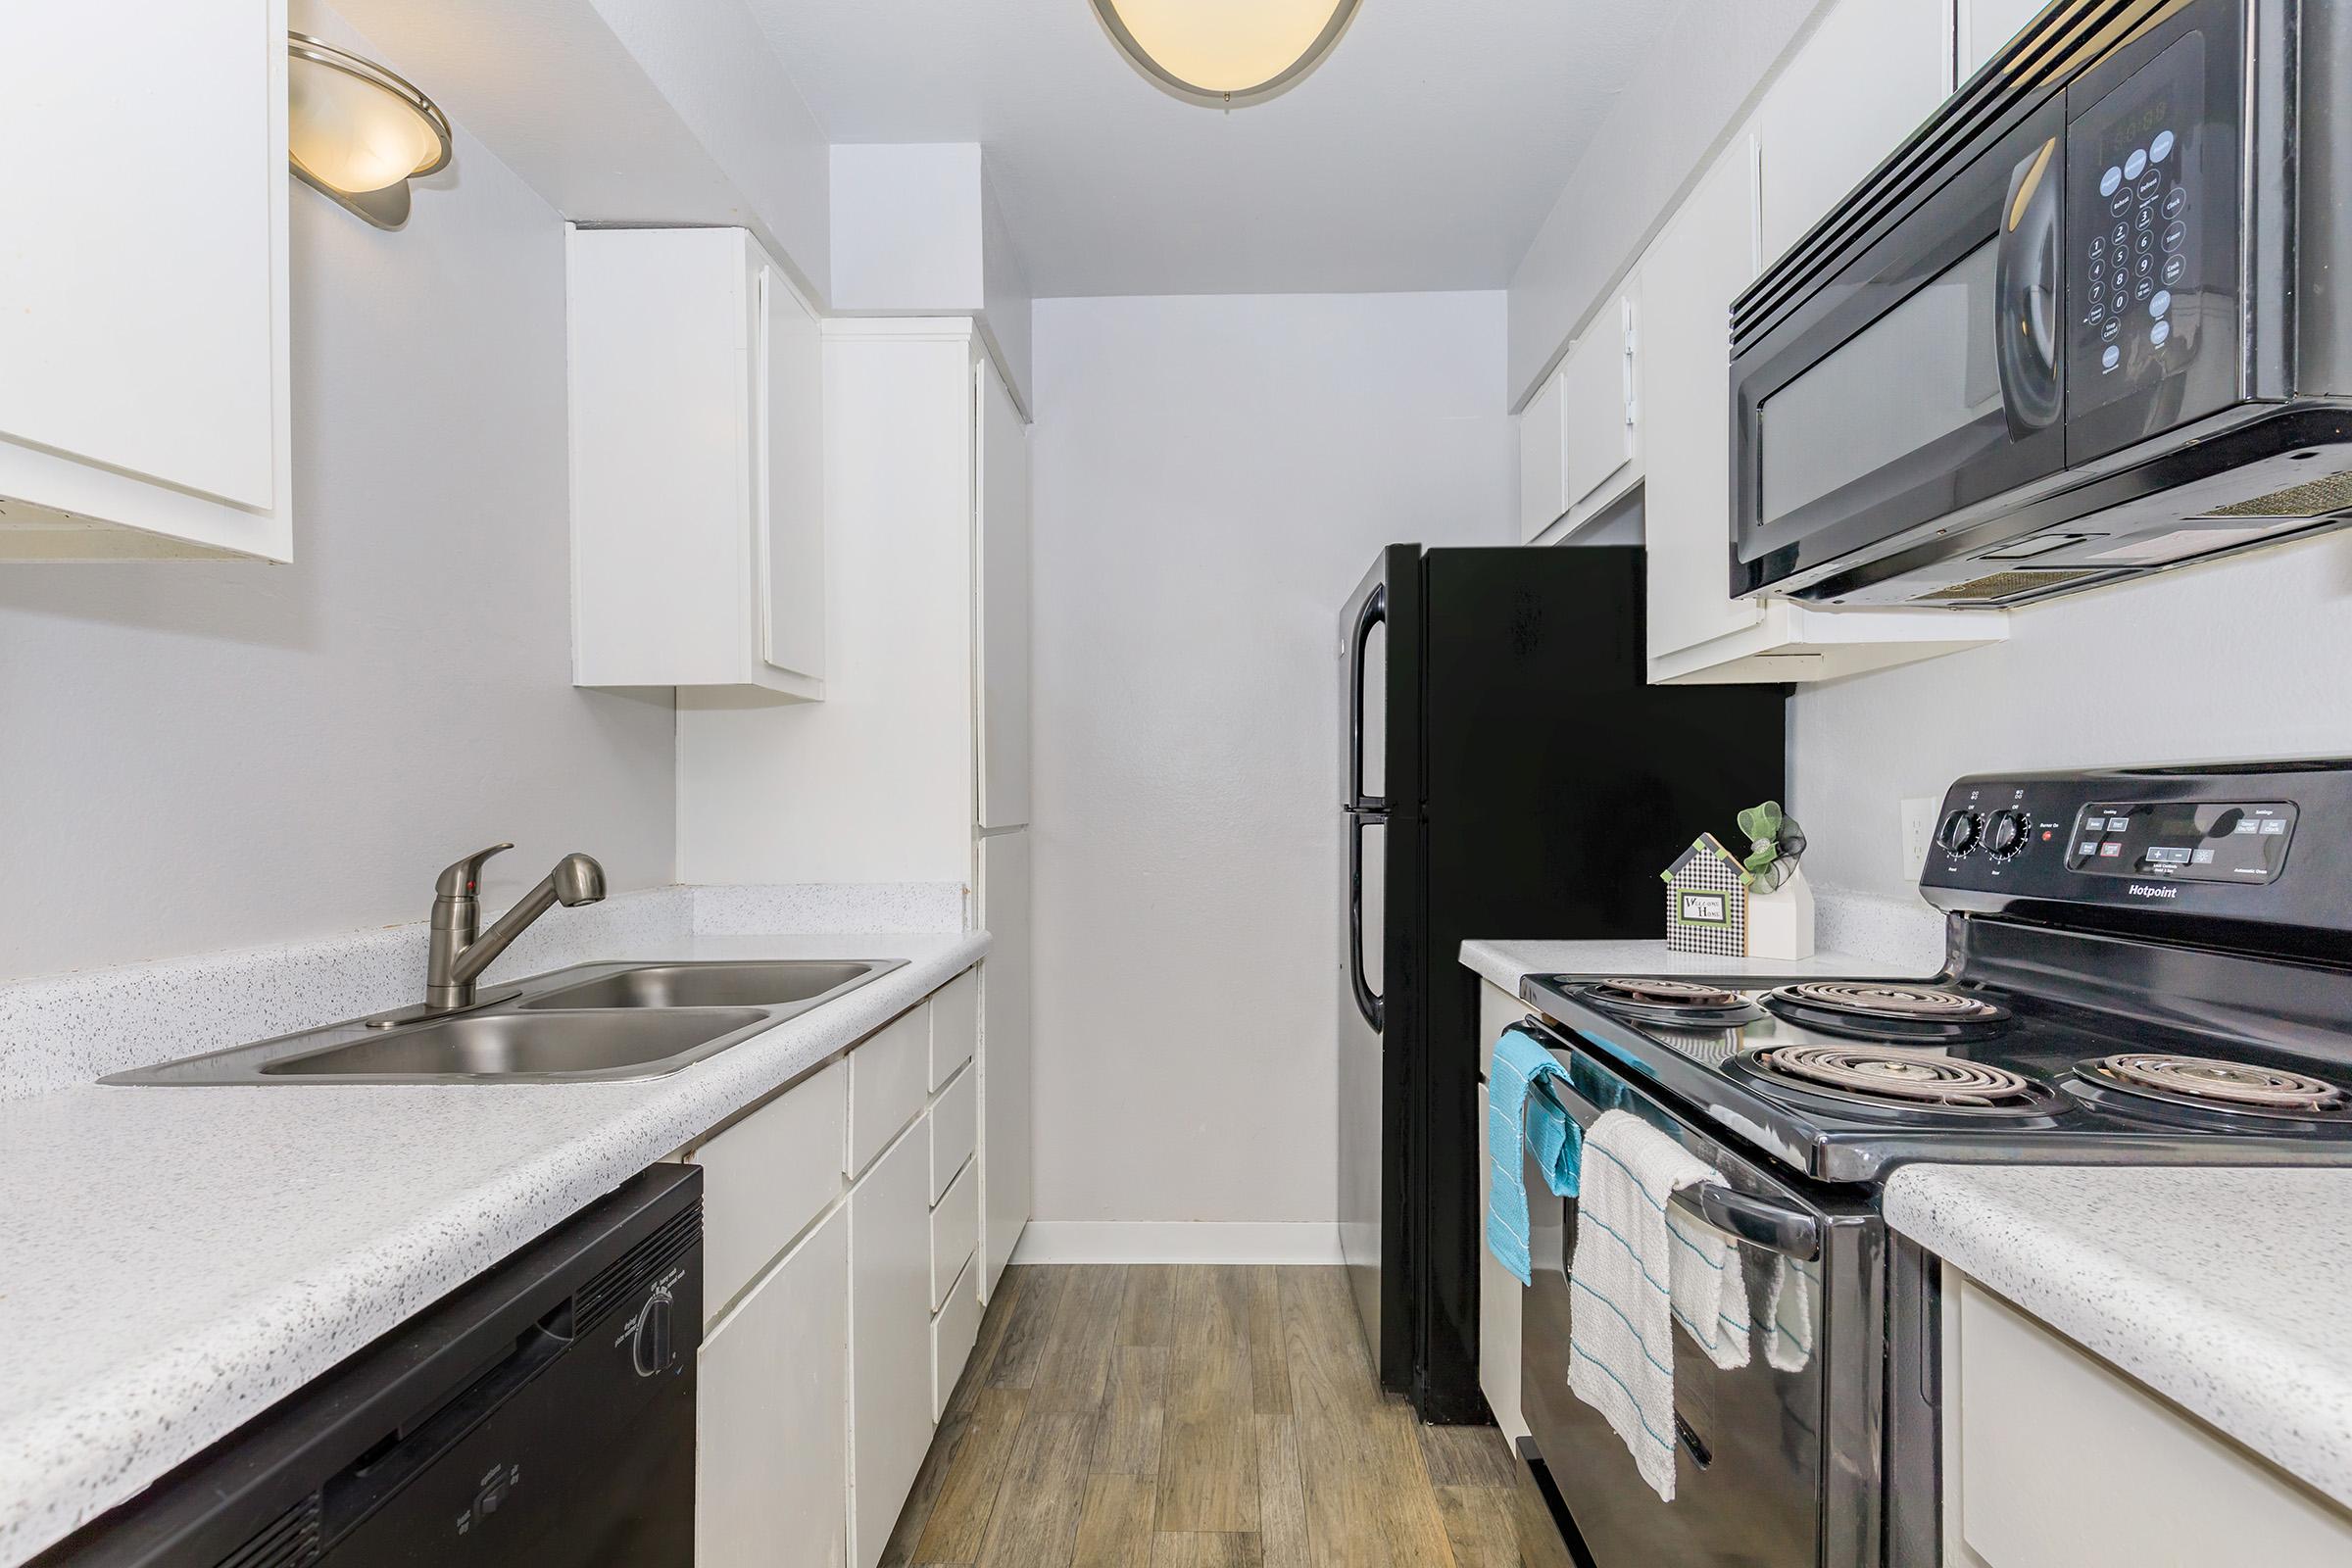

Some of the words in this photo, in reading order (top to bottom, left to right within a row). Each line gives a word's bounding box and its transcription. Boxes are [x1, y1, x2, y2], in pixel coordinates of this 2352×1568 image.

[2140, 177, 2157, 192] Defrost
[2114, 196, 2129, 209] Reheat
[2167, 198, 2180, 210] Clock
[2141, 211, 2147, 221] 3
[2117, 226, 2123, 236] 2
[2141, 236, 2147, 247] 6
[2166, 231, 2180, 243] Timer
[2094, 241, 2099, 250] 1
[2117, 251, 2123, 262] 5
[2094, 266, 2099, 274] 4
[2141, 260, 2147, 271] 9
[2117, 273, 2123, 284] 8
[2093, 286, 2100, 298] 7
[2117, 296, 2123, 308] 0
[2103, 326, 2118, 338] Cancel
[2129, 885, 2178, 898] Hotpoint
